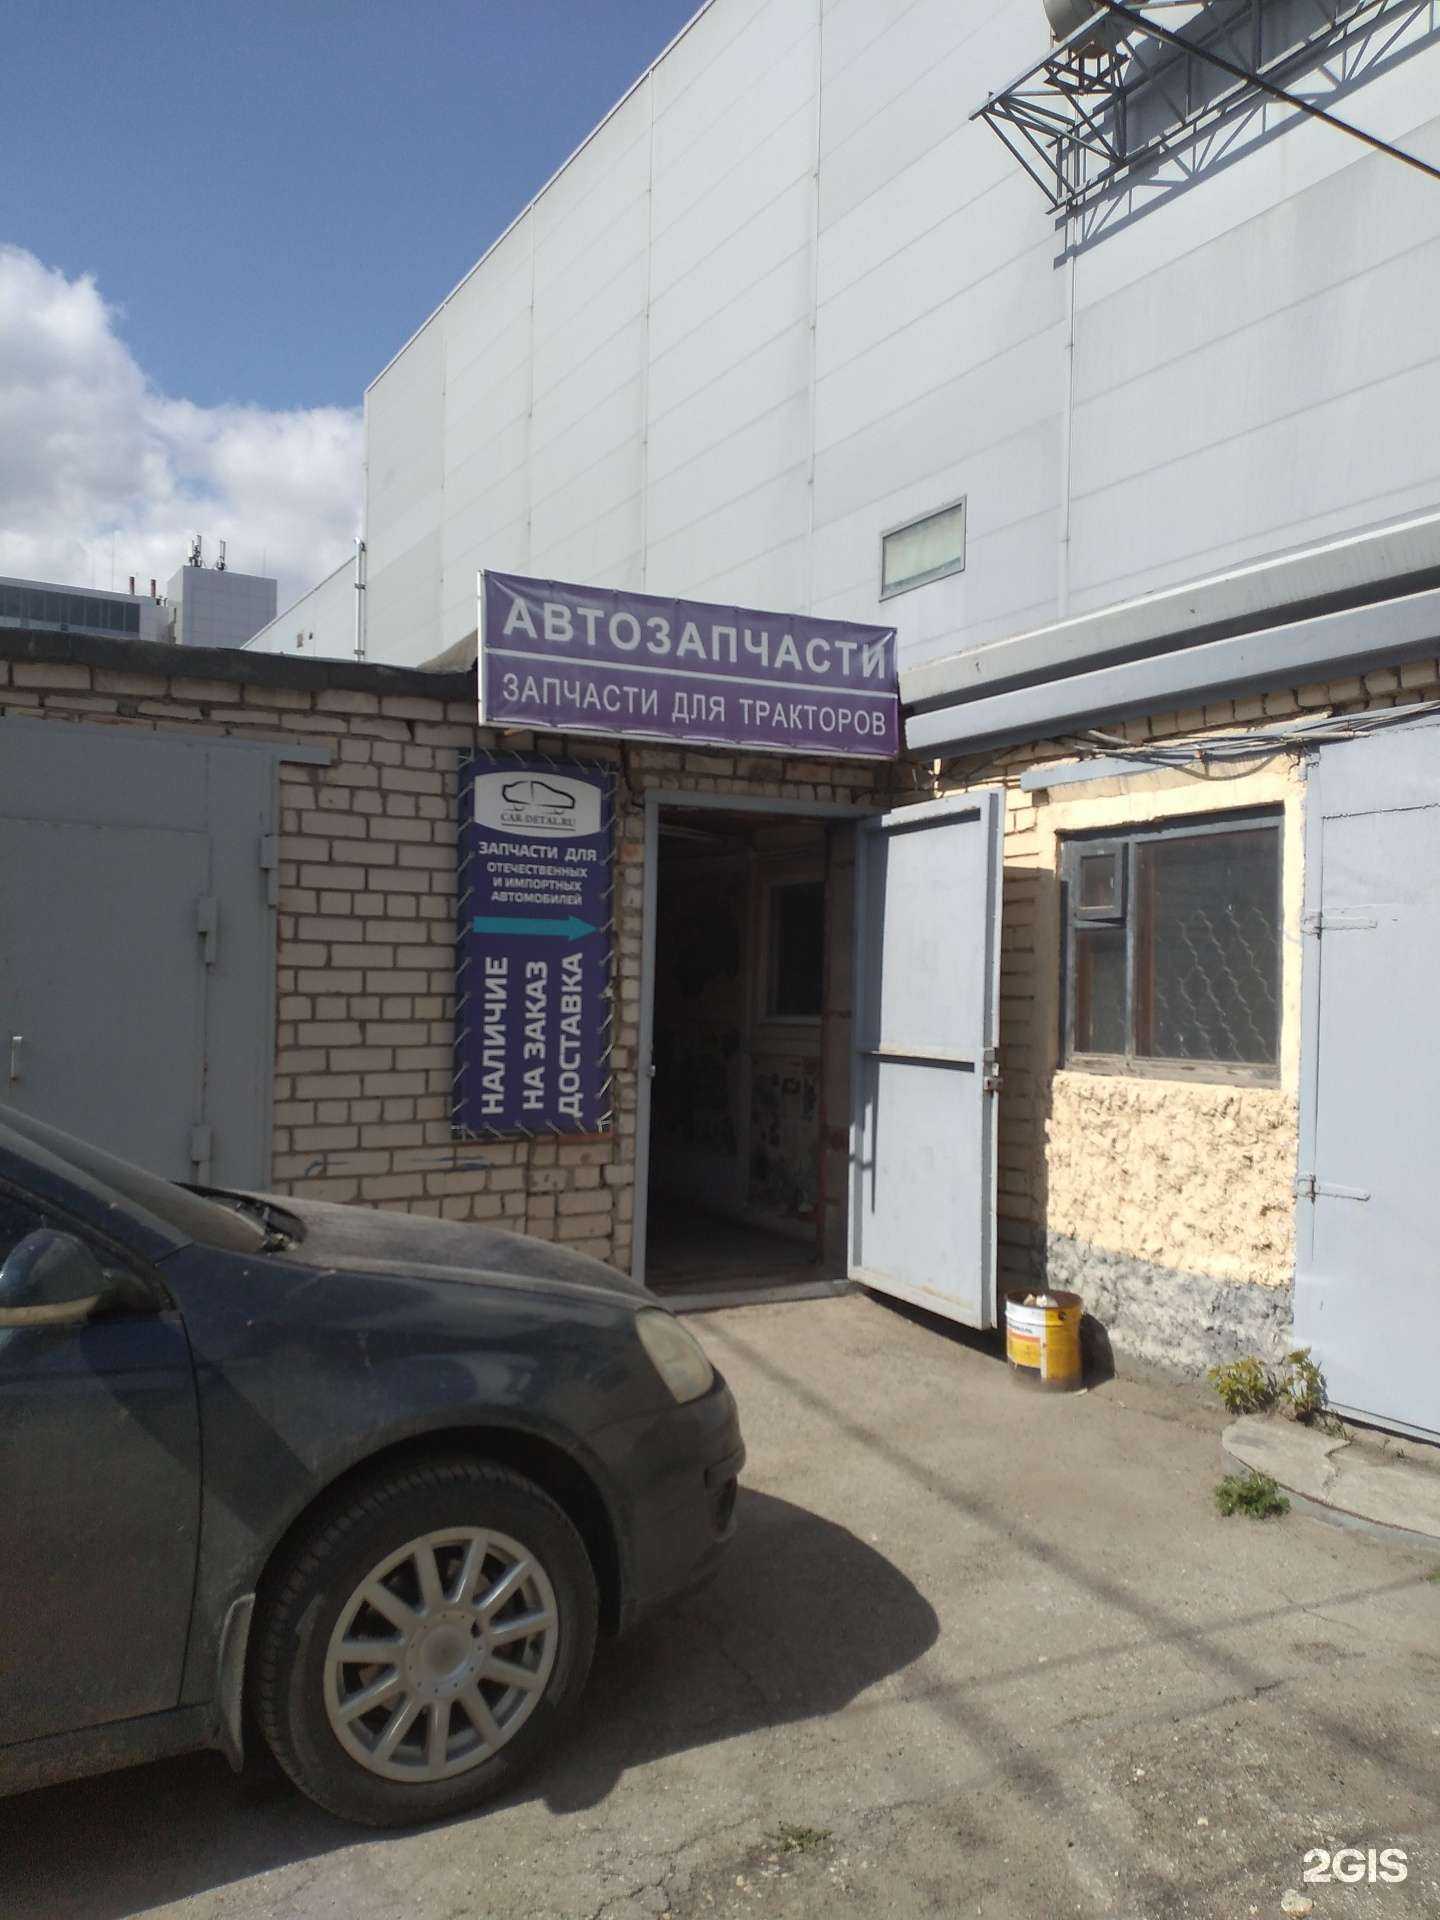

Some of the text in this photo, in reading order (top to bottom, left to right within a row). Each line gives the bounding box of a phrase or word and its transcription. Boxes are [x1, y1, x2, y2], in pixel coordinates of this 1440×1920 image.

[502, 599, 886, 679] АВТОЗАПЧАСТИ
[502, 672, 887, 736] ЗАПЧАСТИ ДЛЯ ТРАКТОРОВ
[478, 841, 597, 862] ЗАПЧАСТИ ДЛЯ
[486, 861, 588, 878] ОТЕЧЕСТВЕННЫХ
[491, 891, 583, 906] АВТОМОБИЛЕЙ
[492, 876, 583, 892] И ИМПОРТНЫХ
[480, 956, 509, 1115] НАЛИЧИЕ
[522, 960, 549, 1111] НА ЗАКАЗ
[557, 952, 584, 1118] ДОСТАВКА
